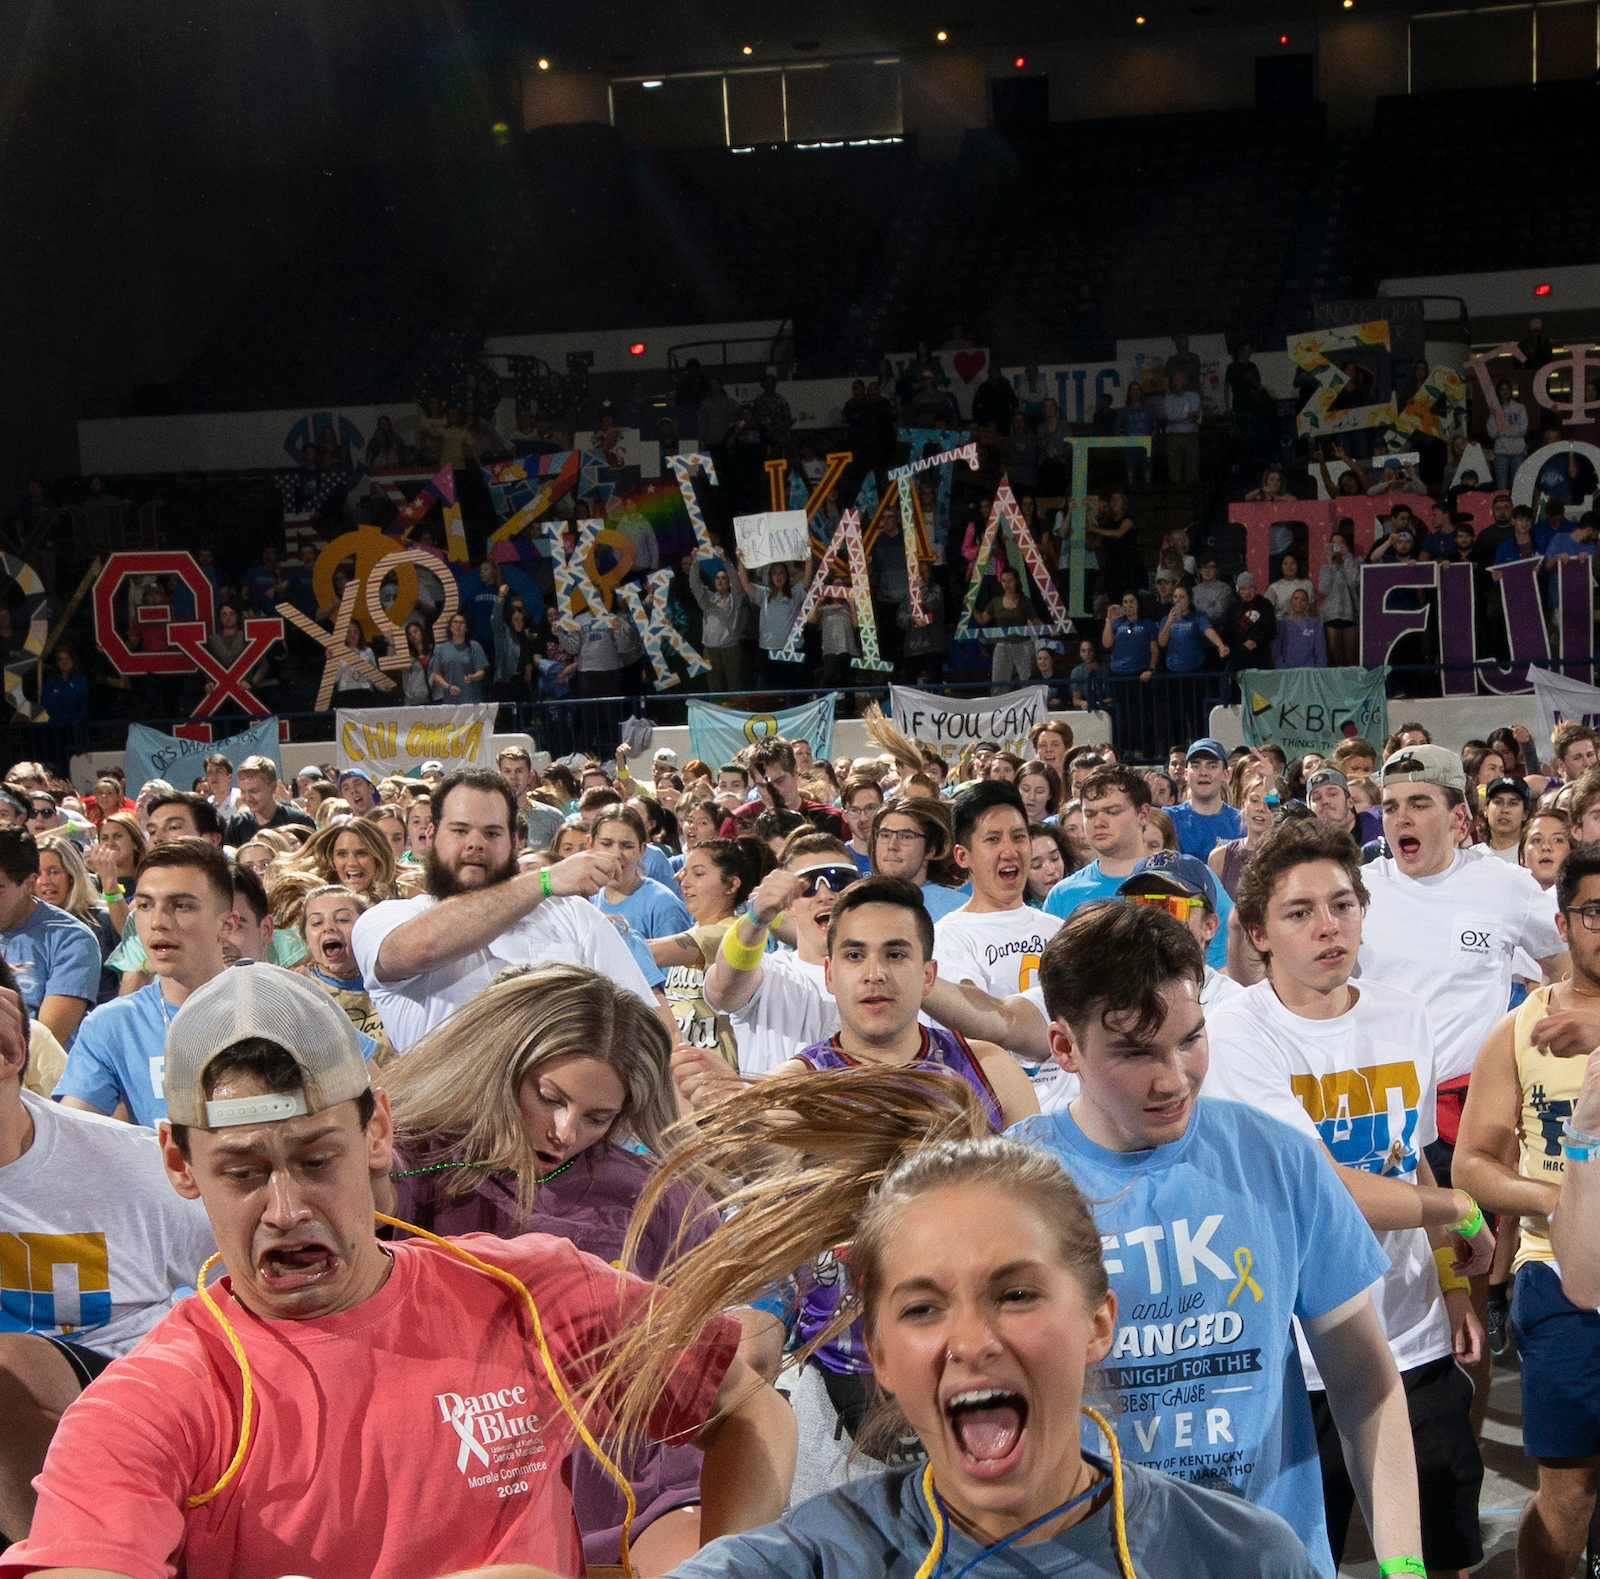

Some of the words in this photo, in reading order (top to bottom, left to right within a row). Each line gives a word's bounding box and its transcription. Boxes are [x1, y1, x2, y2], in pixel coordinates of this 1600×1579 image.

[902, 710, 925, 736] IF
[931, 711, 983, 740] YOU
[991, 703, 1038, 738] CAN
[342, 721, 399, 762] CHI
[405, 721, 485, 763] OMEGA
[1281, 738, 1316, 751] THINKS
[150, 745, 178, 772] OPS
[984, 934, 1048, 967] DanceB
[1542, 1159, 1565, 1172] IHRC
[1131, 1295, 1171, 1321] and
[1177, 1291, 1206, 1314] we
[1113, 1310, 1245, 1360] ANCED
[1119, 1363, 1178, 1387] NIGHT
[1182, 1360, 1209, 1381] FOR
[1216, 1354, 1252, 1375] THE
[434, 1385, 528, 1424] Dance
[1118, 1392, 1161, 1414] BEST
[1161, 1384, 1206, 1407] CAUSE
[474, 1410, 542, 1445] Blue
[492, 1450, 515, 1463] Dance
[515, 1444, 547, 1458] Marathon
[1163, 1456, 1176, 1470] OF
[1179, 1449, 1245, 1467] KENTUCKY
[467, 1471, 499, 1489] Morale
[499, 1460, 548, 1480] Committee
[1189, 1462, 1256, 1481] MARATHO
[496, 1480, 529, 1499] 2020
